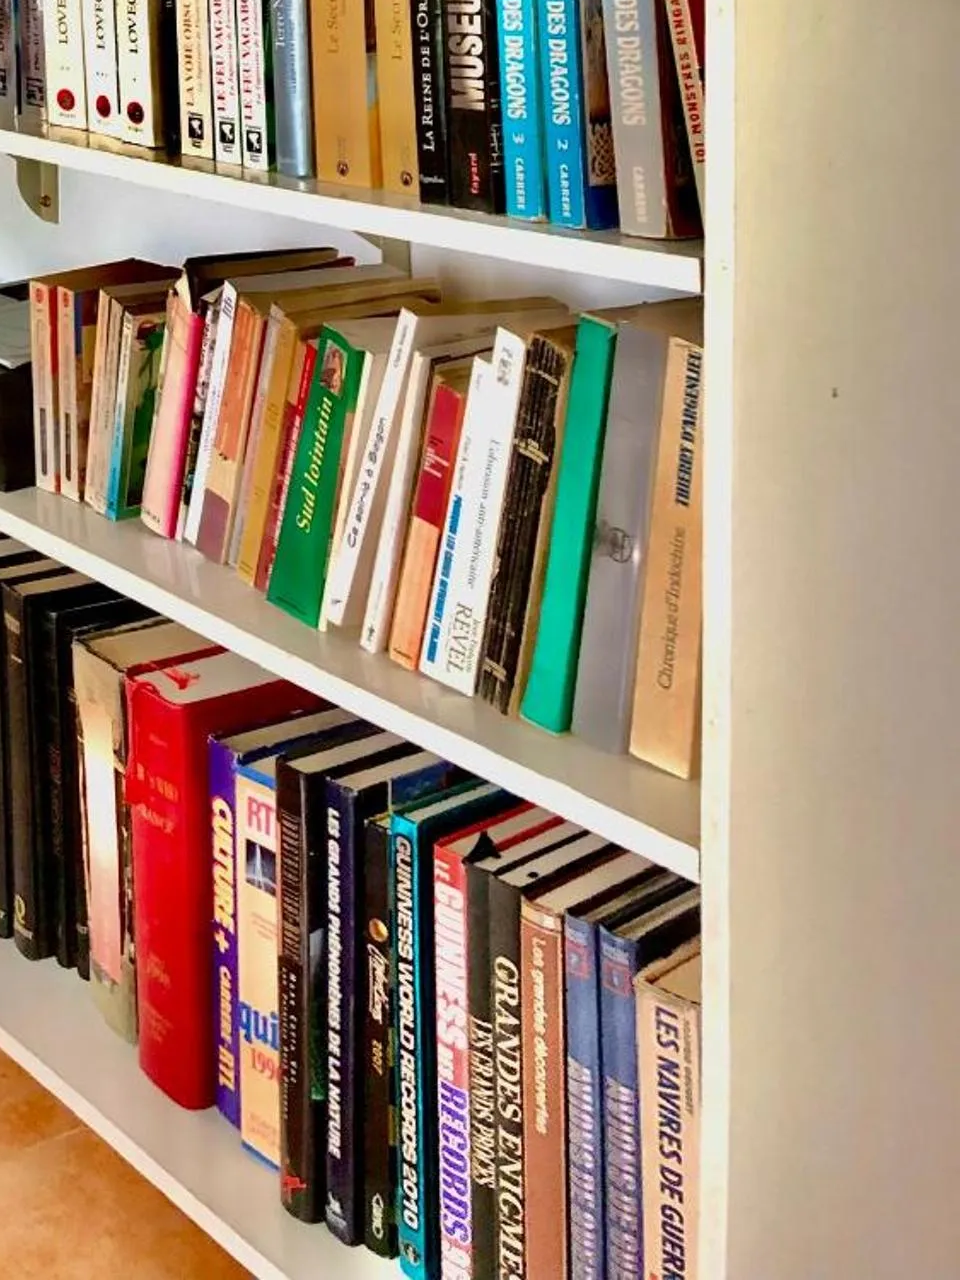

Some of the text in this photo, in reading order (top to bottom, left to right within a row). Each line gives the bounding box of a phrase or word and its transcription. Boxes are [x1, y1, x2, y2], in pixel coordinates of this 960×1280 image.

[274, 12, 287, 49] Terre
[326, 34, 340, 55] Le
[390, 39, 404, 61] Le
[545, 0, 566, 36] DES
[182, 45, 195, 83] VOIE
[184, 87, 196, 108] LA
[214, 56, 226, 86] FEU
[242, 63, 253, 94] FEU
[504, 34, 527, 120] DRAGONS
[547, 38, 571, 126] DRAGONS
[620, 35, 645, 126] DRAGONS
[677, 50, 704, 136] MONSTRES
[216, 90, 227, 112] LE
[243, 98, 254, 121] LE
[513, 132, 525, 145] 3
[557, 138, 569, 151] 2
[673, 349, 703, 508] THIERRY D'ARGENLIEU
[295, 395, 334, 535] Sud lointain
[445, 601, 474, 675] REVEL
[654, 525, 687, 691] Chronique d'Indochine
[211, 796, 237, 935] CULTURE
[327, 807, 344, 1159] LES GRANDS PHÉNOMÈNES DE LA NATURE
[436, 883, 469, 1050] GUINNESS
[395, 835, 420, 1230] GUINNESS WORLD RECORDS 2010
[471, 1018, 496, 1051] LES
[495, 955, 522, 1123] GRANDES
[531, 935, 550, 1135] Les grandes découvertes
[655, 1005, 681, 1051] LES
[471, 1052, 496, 1123] GRANDS
[657, 1056, 684, 1163] NAVIRES
[439, 1079, 472, 1243] RECORDS
[659, 1165, 684, 1202] DE
